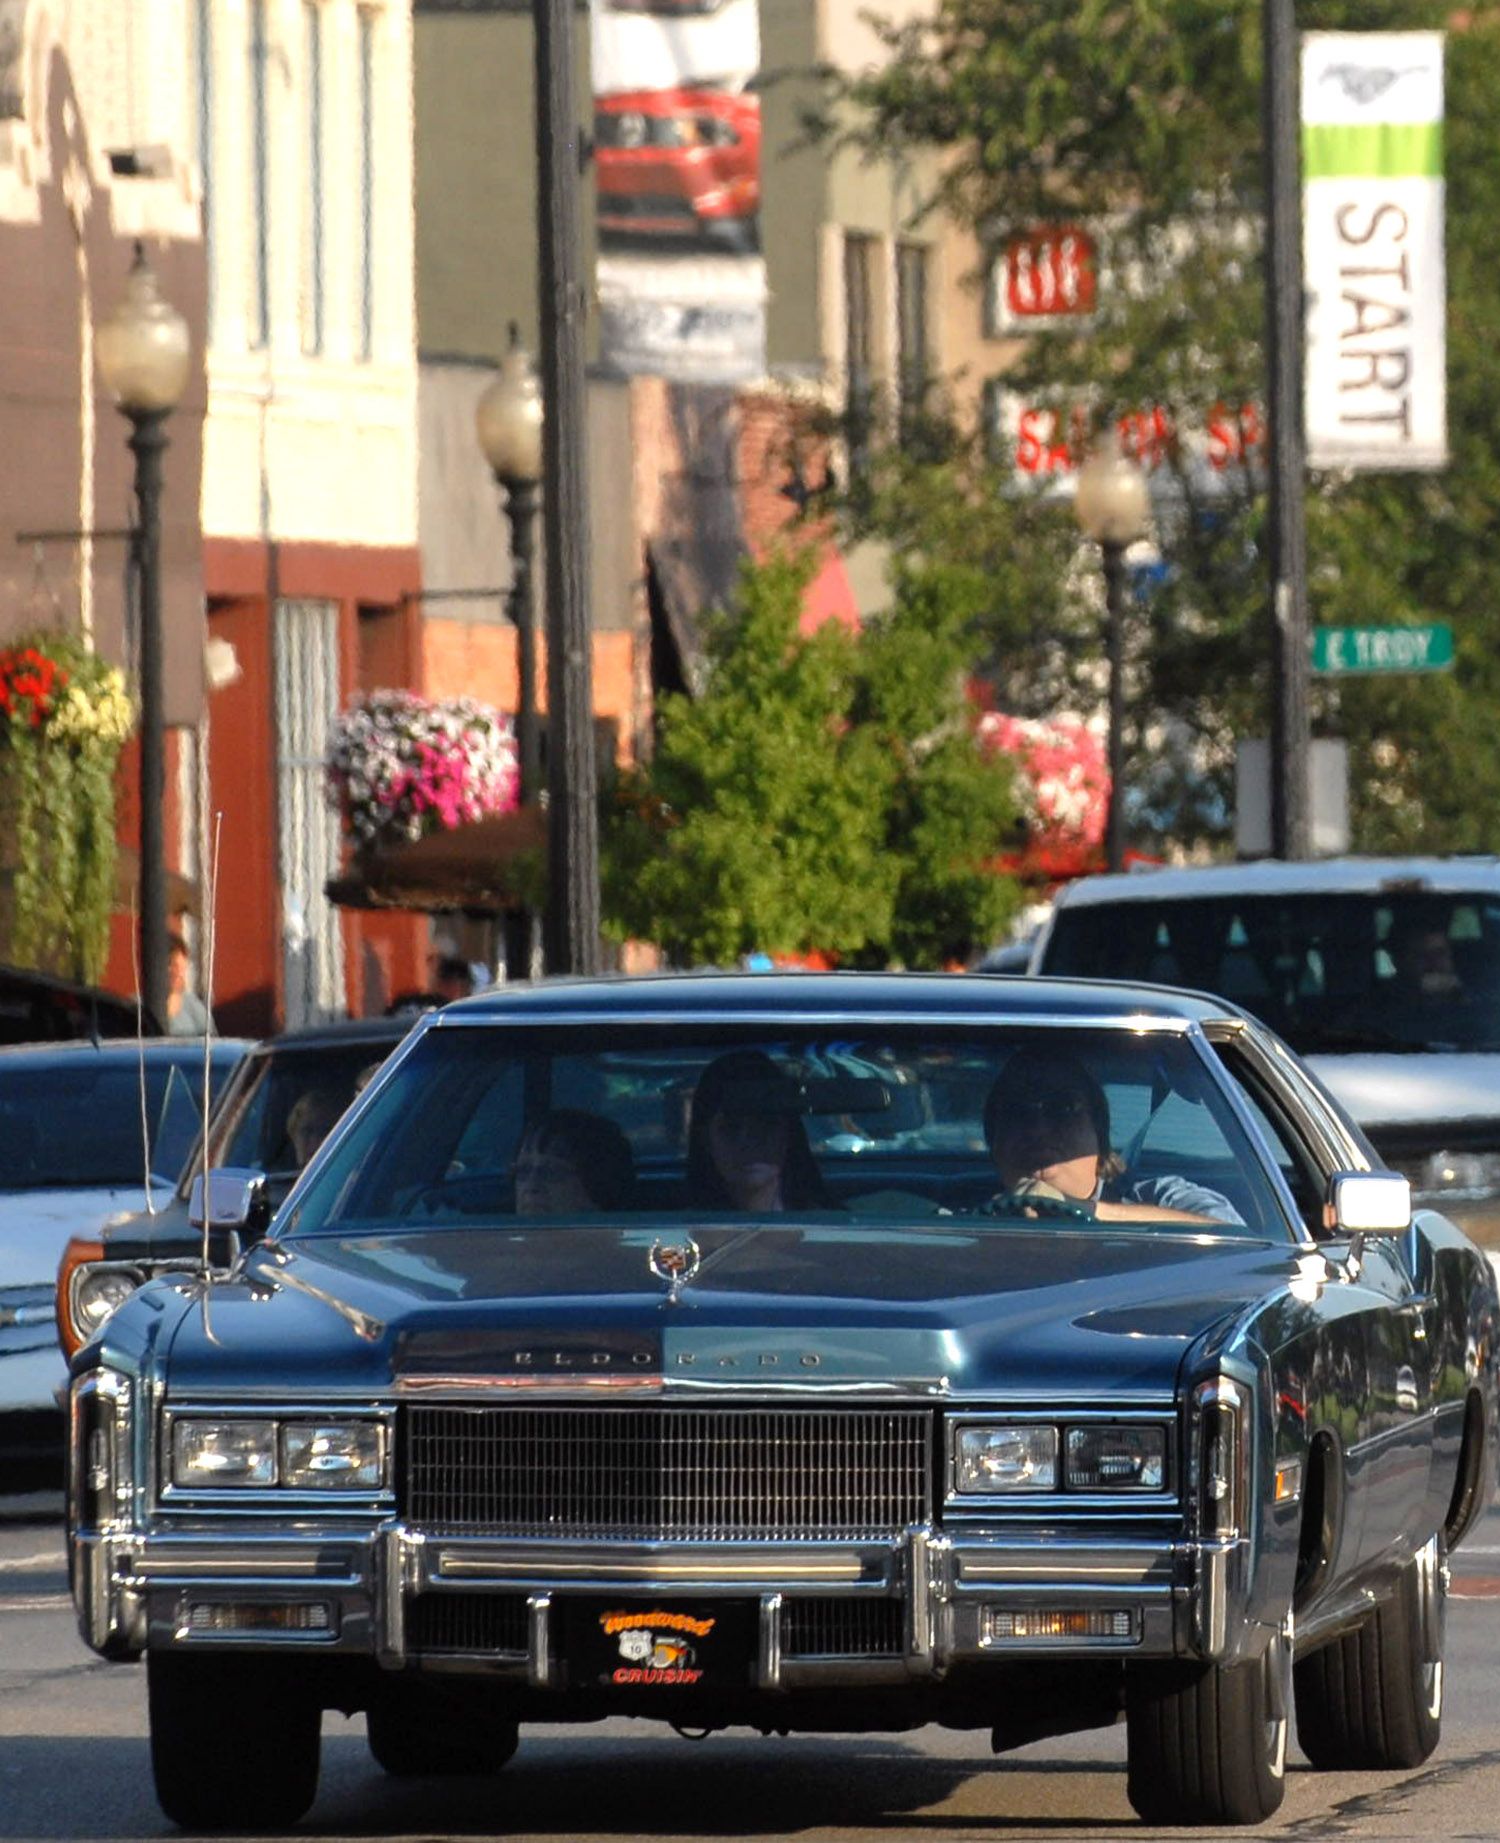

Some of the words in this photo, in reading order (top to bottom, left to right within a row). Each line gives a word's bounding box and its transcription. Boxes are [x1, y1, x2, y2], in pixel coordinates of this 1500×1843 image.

[1334, 203, 1412, 441] START
[1326, 630, 1344, 670] E
[1353, 629, 1433, 668] TROY
[515, 1352, 820, 1367] ELDORADO
[630, 1645, 643, 1655] 10
